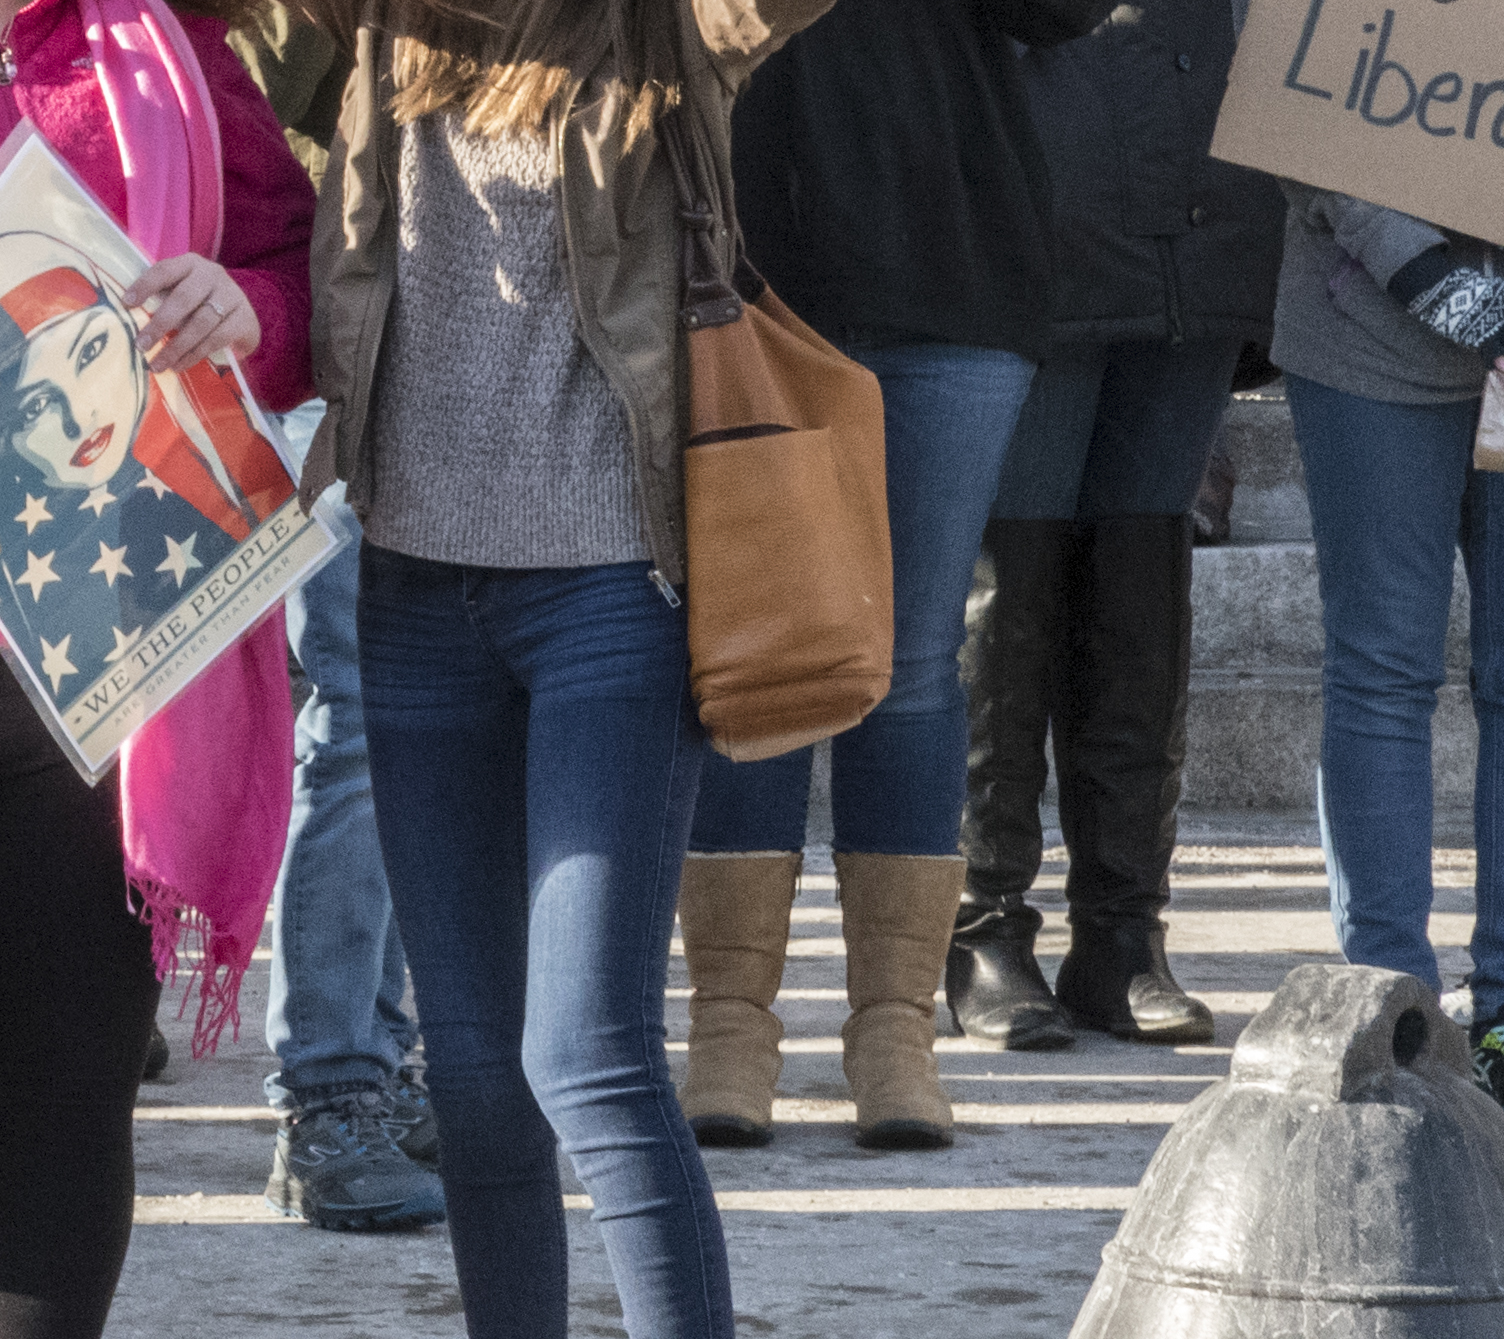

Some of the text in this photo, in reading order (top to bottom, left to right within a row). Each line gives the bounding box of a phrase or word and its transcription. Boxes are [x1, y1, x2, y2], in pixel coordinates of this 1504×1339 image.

[82, 516, 291, 716] WE THE PEOPLE
